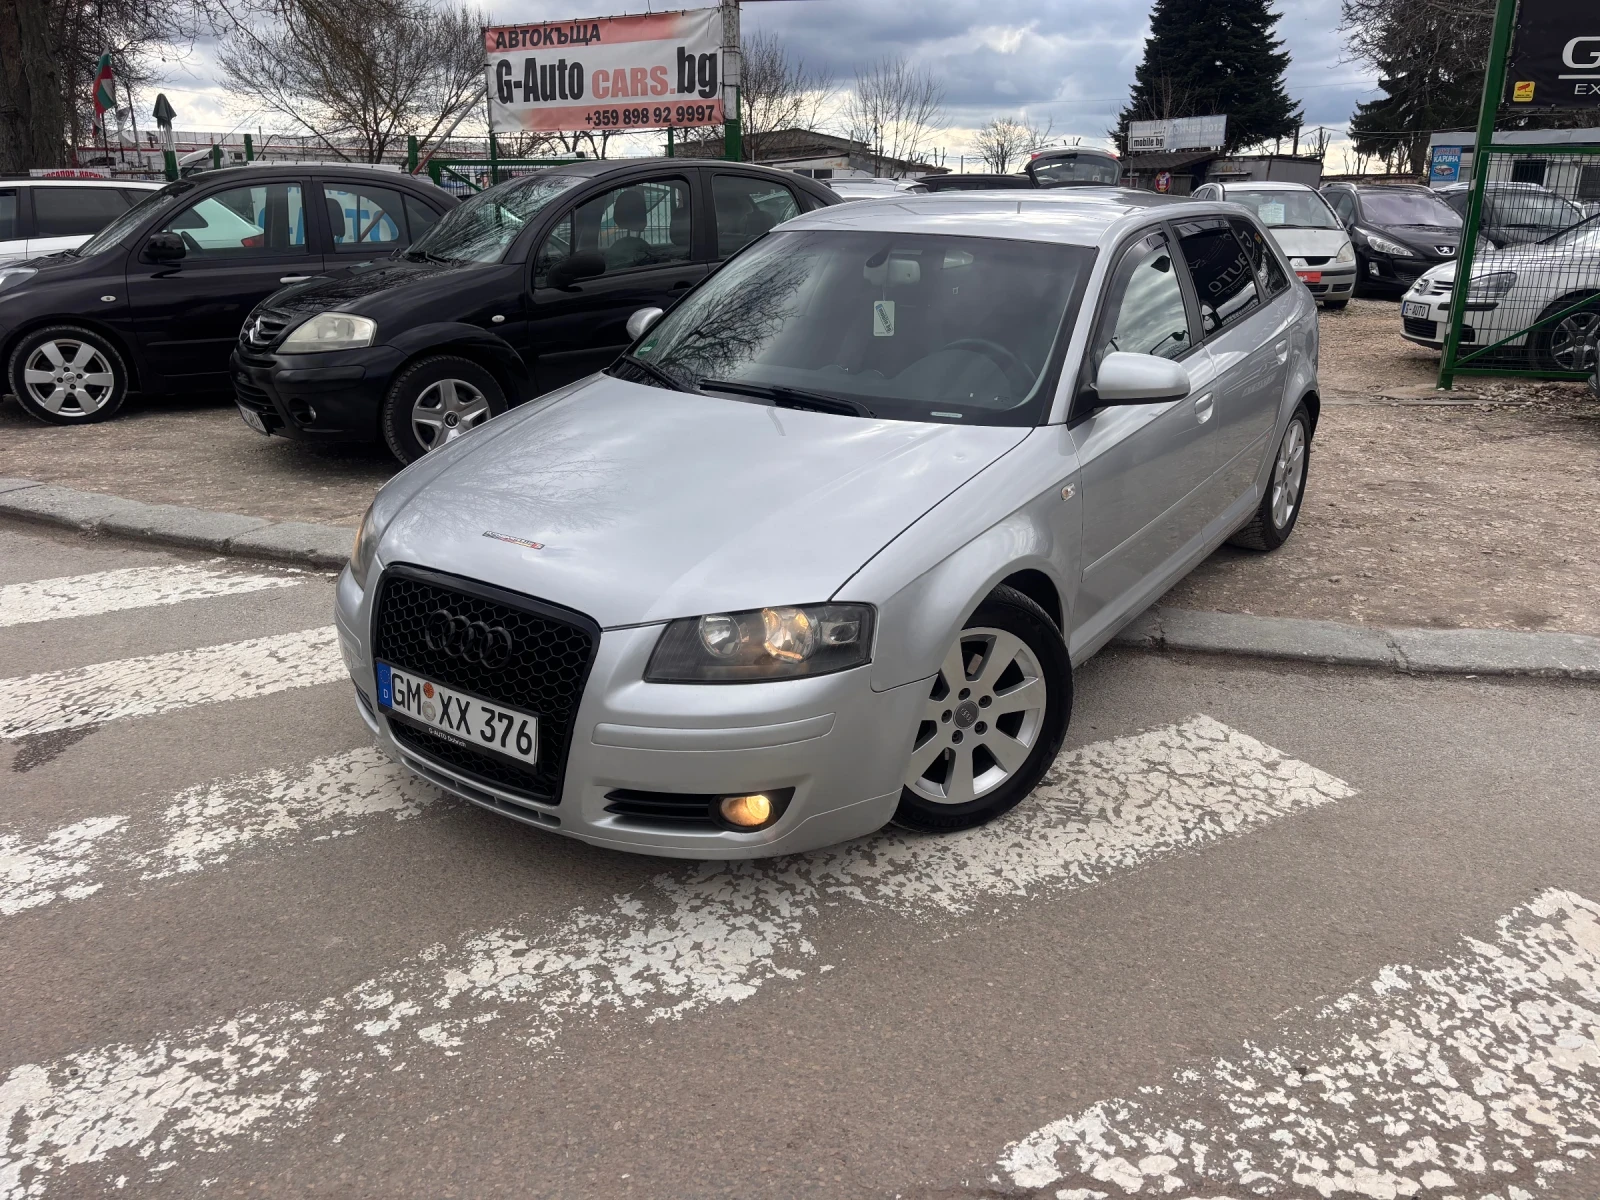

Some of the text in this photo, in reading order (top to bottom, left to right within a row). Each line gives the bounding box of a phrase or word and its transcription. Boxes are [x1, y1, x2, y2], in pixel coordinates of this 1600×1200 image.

[496, 24, 601, 49] АВТОКЪЩА
[496, 57, 584, 104] G-Auto
[585, 105, 715, 126] +359 898 92 9997
[1203, 123, 1224, 132] 2012
[383, 689, 389, 699] D
[392, 673, 532, 755] GM XX 376
